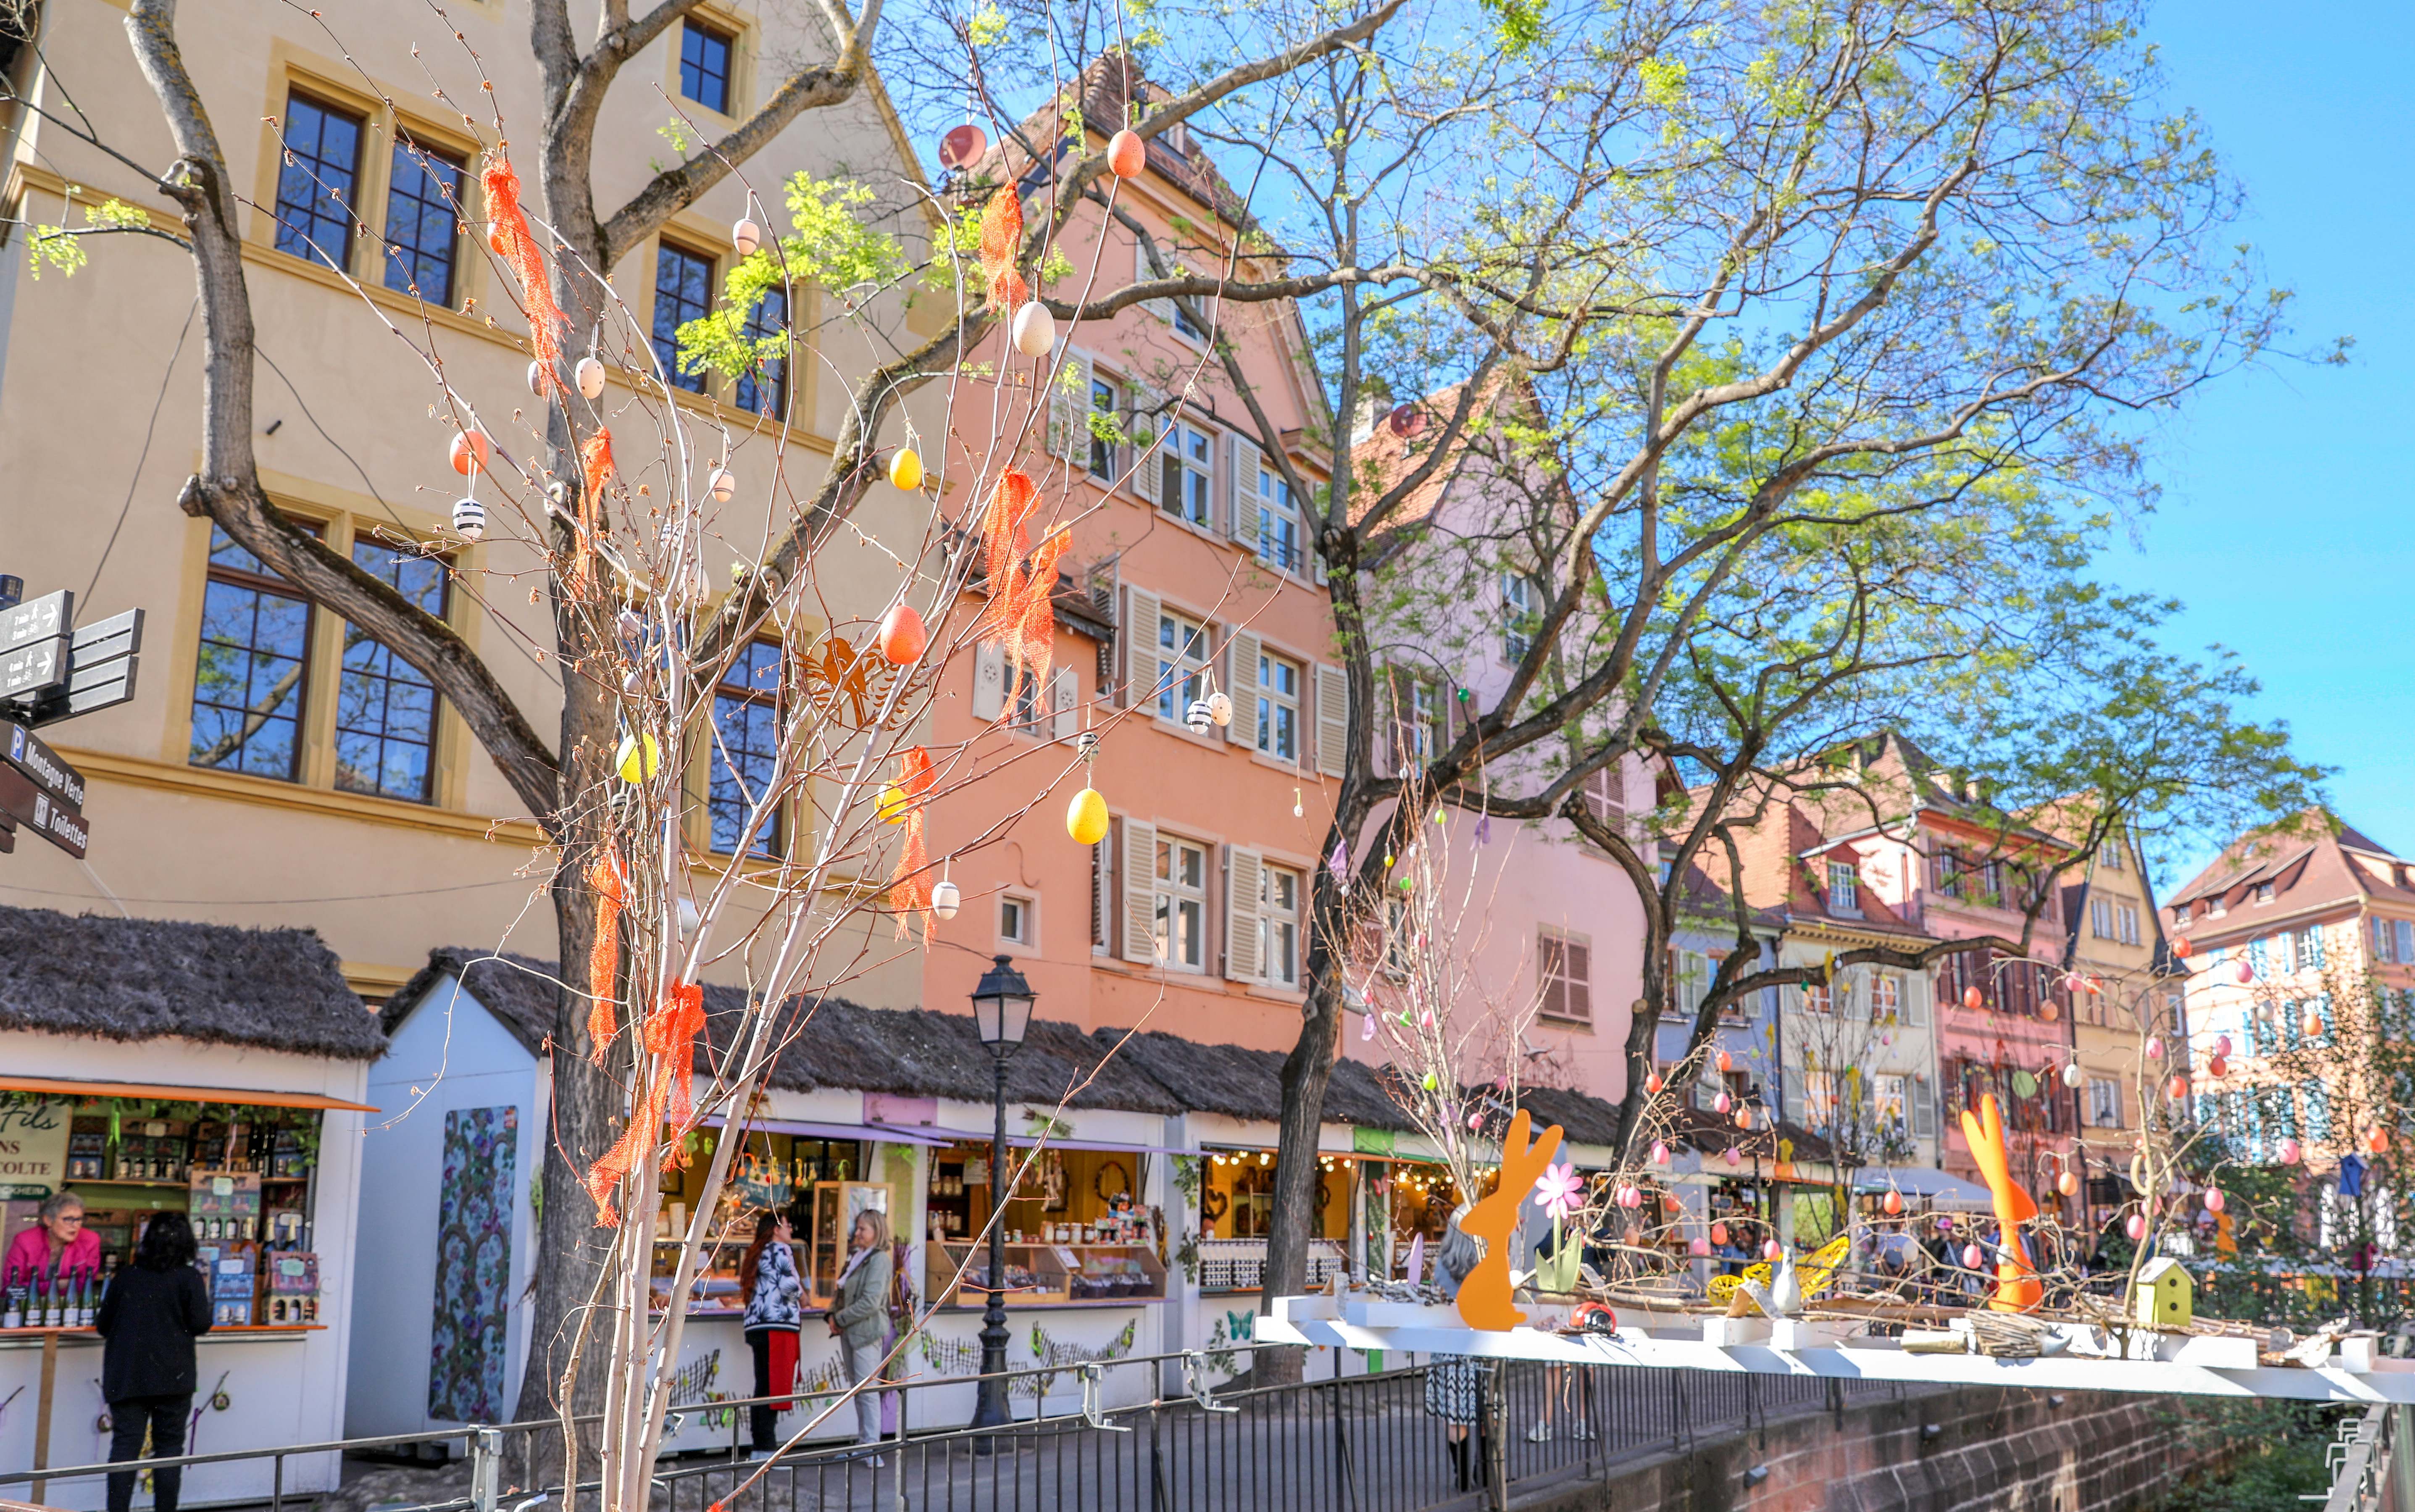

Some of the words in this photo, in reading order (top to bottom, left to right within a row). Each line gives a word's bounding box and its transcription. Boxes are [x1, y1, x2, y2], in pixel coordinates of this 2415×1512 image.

[18, 613, 29, 624] min
[12, 631, 17, 641] 3
[16, 628, 27, 639] min
[9, 663, 13, 672] 4
[13, 660, 24, 671] min
[7, 678, 11, 687] 1
[11, 676, 21, 686] min
[13, 730, 22, 754] P
[25, 741, 63, 789] Montagne
[64, 773, 84, 805] Verte
[50, 807, 87, 849] Toilettes
